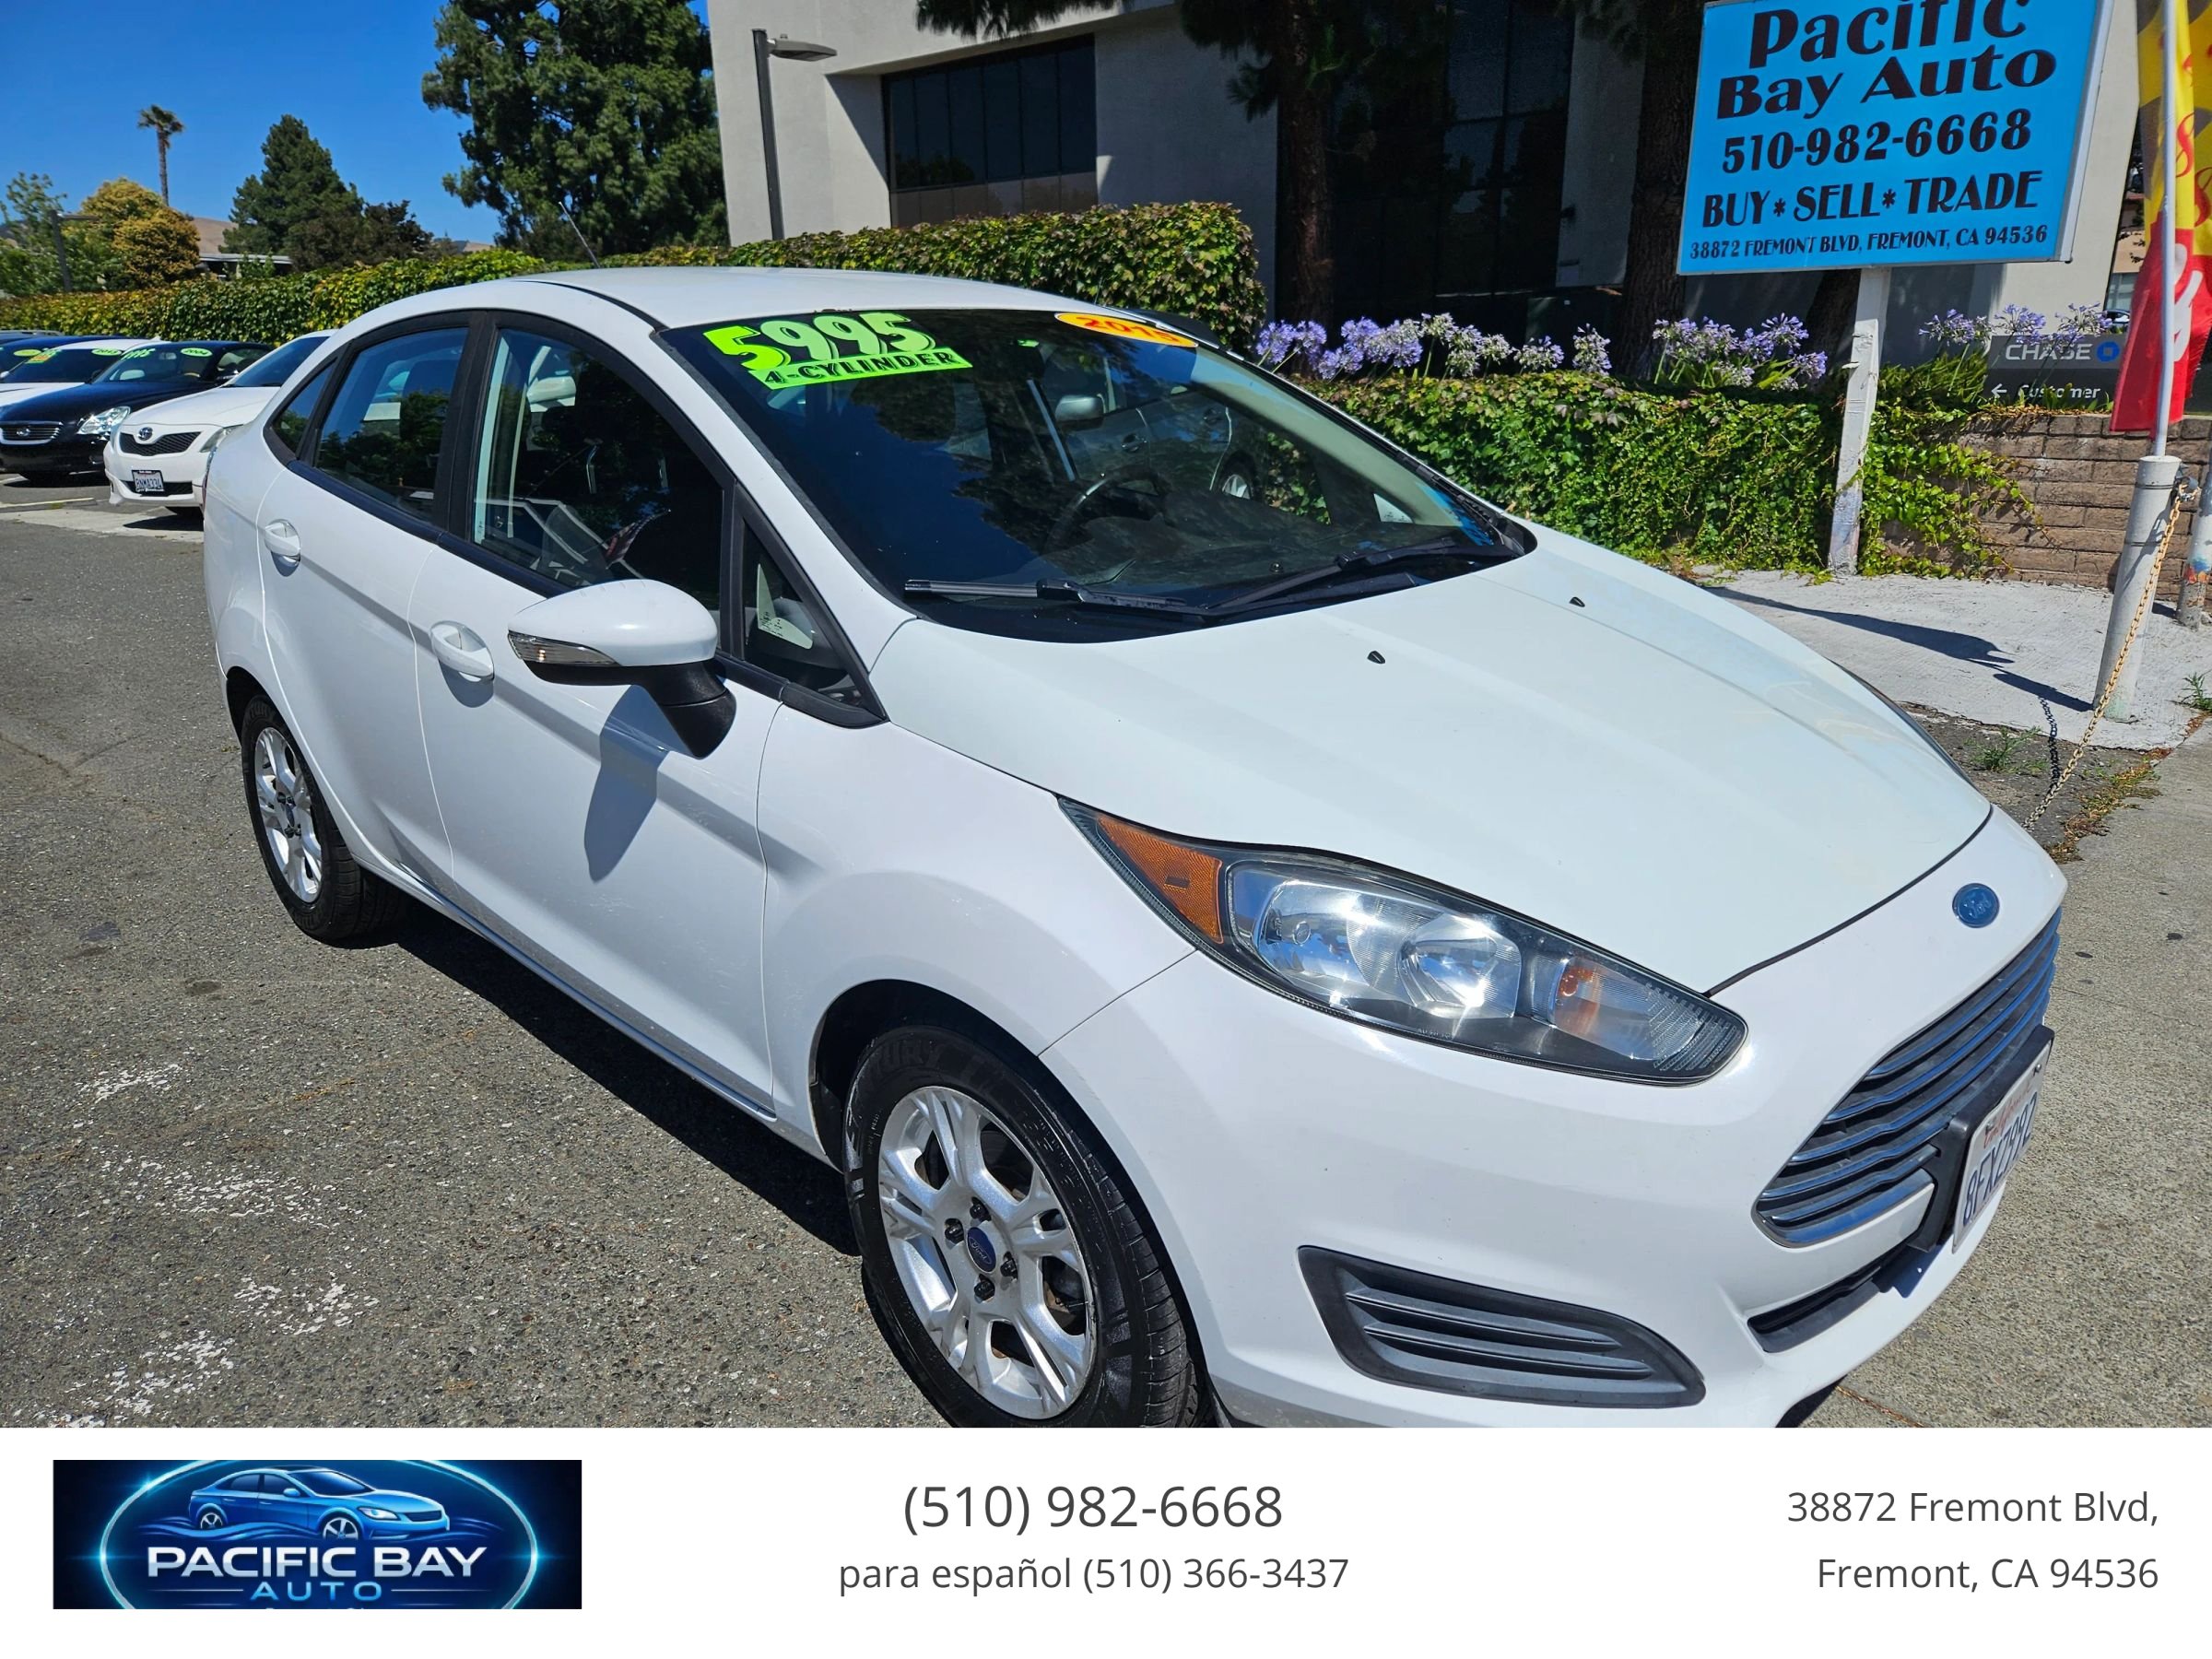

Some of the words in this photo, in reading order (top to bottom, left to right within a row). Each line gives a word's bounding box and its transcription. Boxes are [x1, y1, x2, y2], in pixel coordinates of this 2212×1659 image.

[1749, 0, 2029, 69] Pacific
[1716, 74, 1844, 120] Bay
[1860, 48, 2058, 104] Auto
[1721, 108, 2032, 174] 510-982-6668
[1702, 191, 1771, 228] BUY
[1793, 182, 1882, 222] SELL
[1904, 170, 2043, 215] TRADE
[1689, 240, 1741, 259] 38872
[1744, 236, 1816, 257] FREMONT
[1819, 233, 1863, 253] BLVD,
[1867, 229, 1951, 252] FREMONT,
[1956, 227, 1980, 246] CA
[1984, 224, 2049, 245] 94536
[702, 312, 938, 371] 5995
[1075, 316, 1181, 343] 2015
[763, 350, 958, 384] 4-CYLINDER
[2018, 384, 2101, 398] Cusomer
